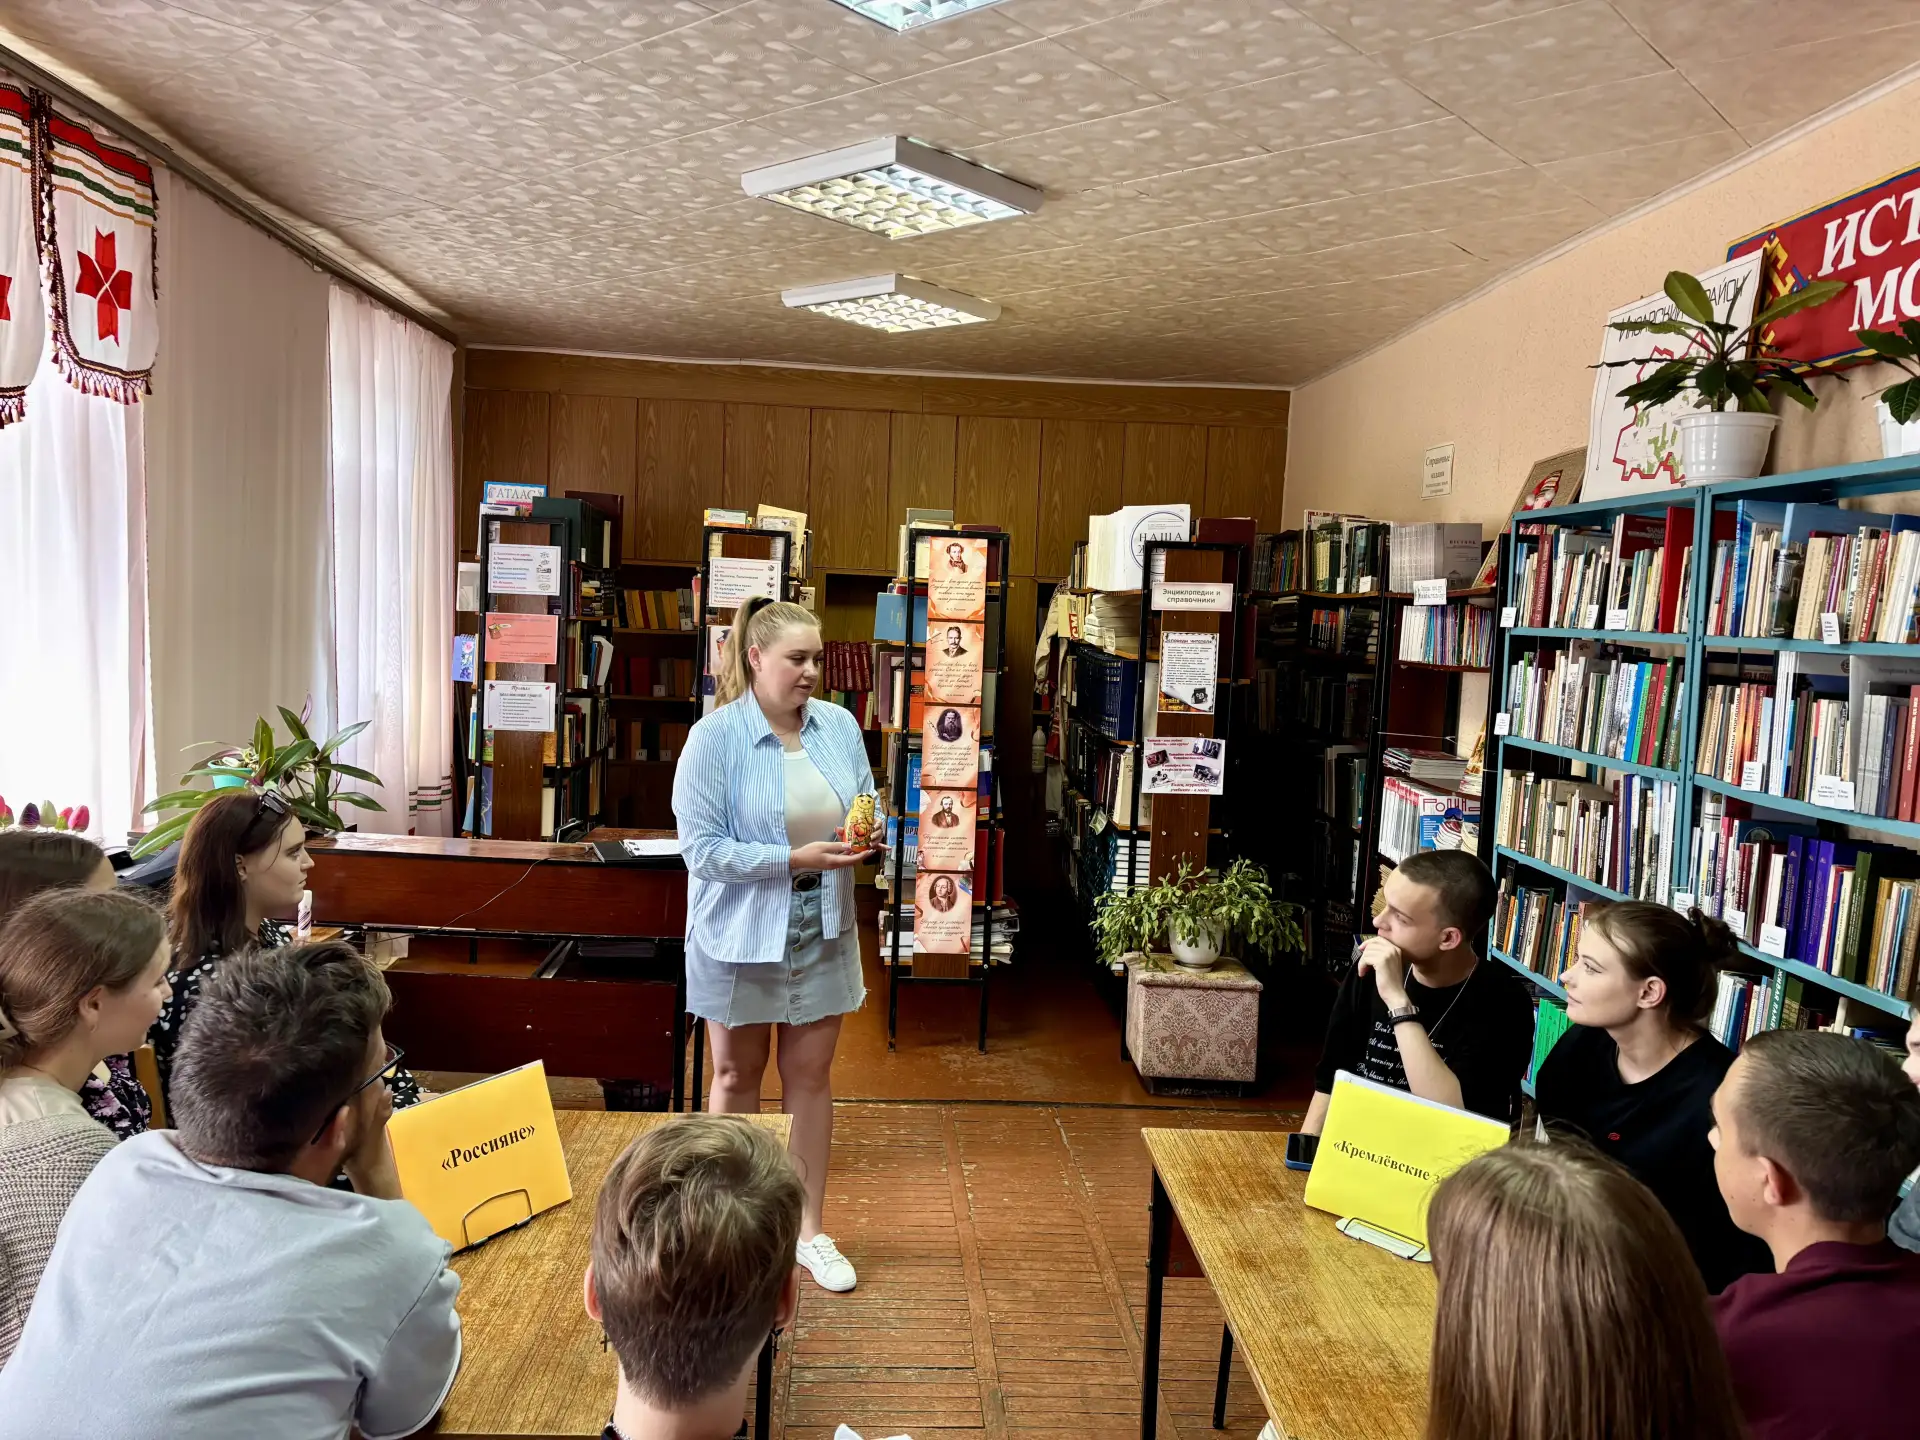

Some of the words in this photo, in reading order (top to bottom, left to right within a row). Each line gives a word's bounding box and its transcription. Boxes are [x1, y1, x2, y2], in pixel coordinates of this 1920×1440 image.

[1817, 186, 1920, 277] ИСТ
[496, 488, 536, 500] АТЛАС
[1162, 588, 1214, 596] Энциклопедии
[1773, 968, 1783, 1003] ЖИВАЯ
[1371, 1058, 1394, 1069] morning
[441, 1124, 535, 1170] «Россияне»
[1333, 1140, 1430, 1181] «Кремлёвские
